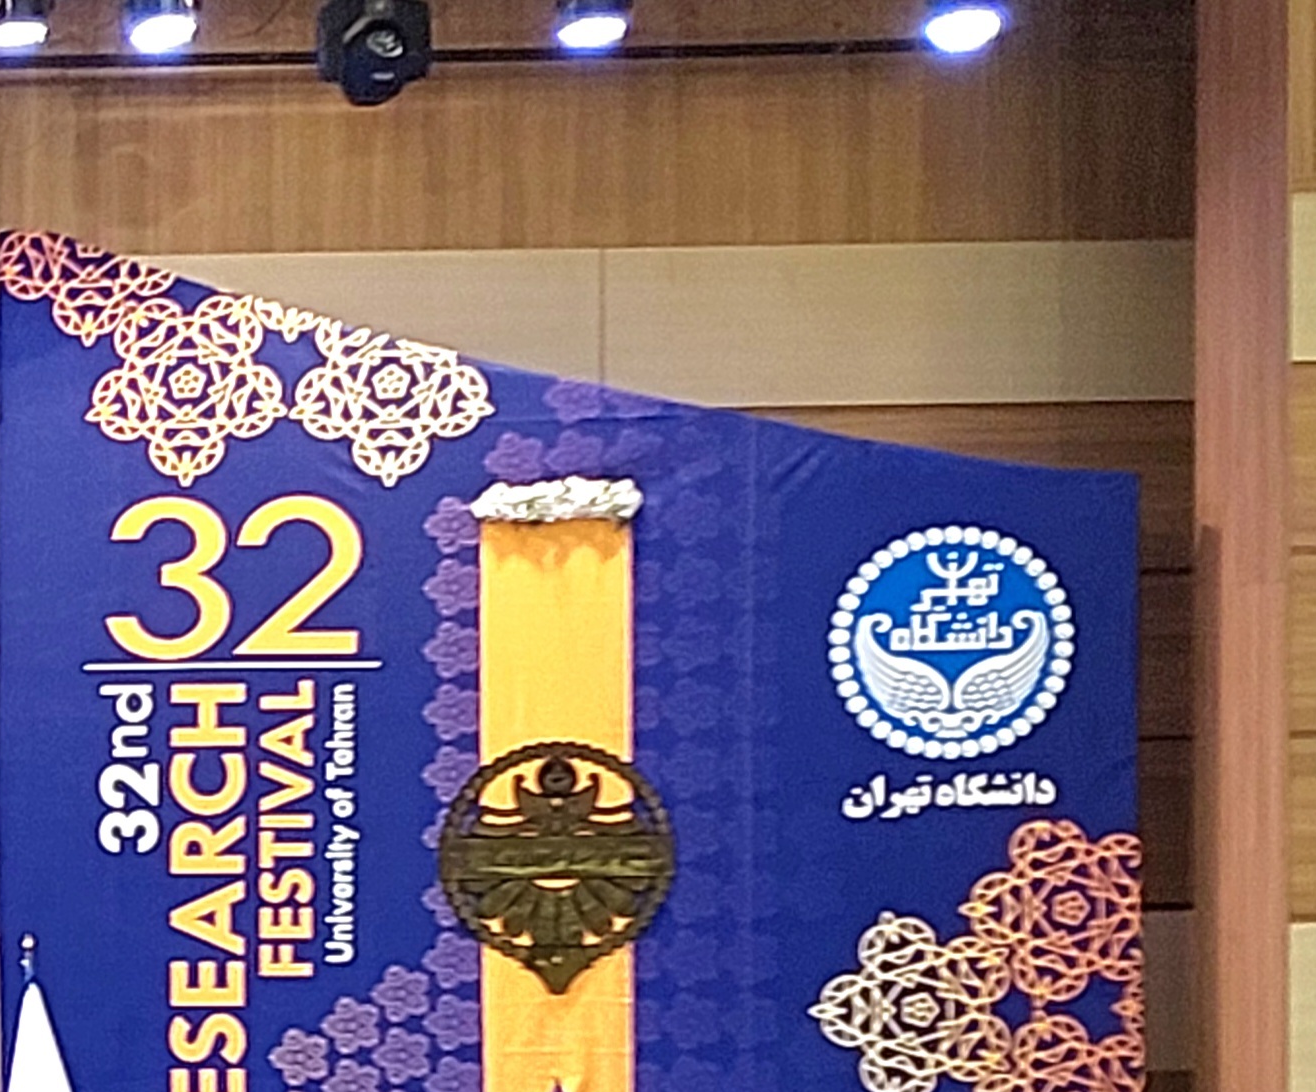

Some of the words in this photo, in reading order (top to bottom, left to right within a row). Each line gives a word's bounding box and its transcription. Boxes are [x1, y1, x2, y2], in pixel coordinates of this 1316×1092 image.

[104, 495, 362, 659] 32
[98, 682, 160, 854] 32nd
[324, 683, 356, 781] Tehran
[935, 772, 1056, 806] دانشگاه
[258, 678, 315, 978] FESTIVAL
[324, 787, 355, 818] of
[842, 774, 933, 818] تهران
[324, 823, 360, 964] University
